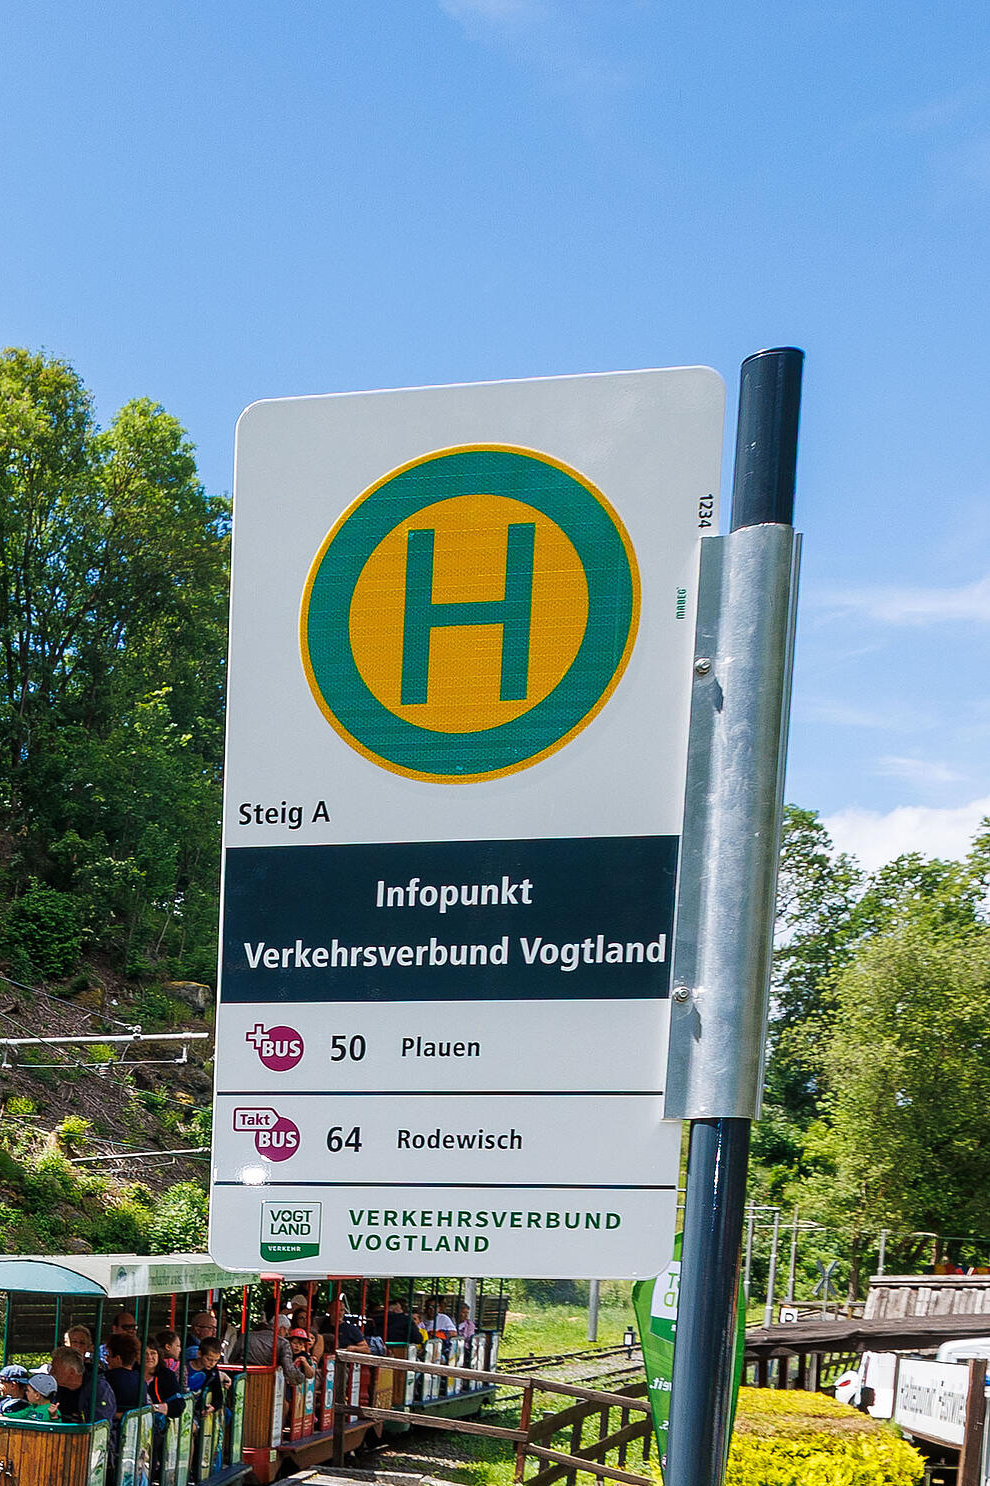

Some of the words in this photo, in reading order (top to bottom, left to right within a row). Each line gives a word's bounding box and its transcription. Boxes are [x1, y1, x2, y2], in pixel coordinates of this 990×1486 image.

[698, 494, 714, 528] 1234
[400, 522, 536, 706] H
[238, 801, 303, 830] Steig
[312, 800, 330, 823] A
[376, 876, 533, 913] Infopunkt
[244, 936, 509, 969] Verkehrsverbund
[520, 933, 667, 972] Vogtland
[330, 1035, 367, 1062] 50
[401, 1036, 481, 1058] Plauen
[240, 1113, 270, 1126] Takt
[258, 1131, 298, 1148] BUS
[326, 1126, 362, 1153] 64
[397, 1129, 523, 1150] Rodewisch
[270, 1209, 312, 1223] VOGT
[270, 1222, 311, 1236] LAND
[348, 1209, 621, 1232] VERKEHRSVERBUND
[348, 1233, 489, 1253] VOGTLAND
